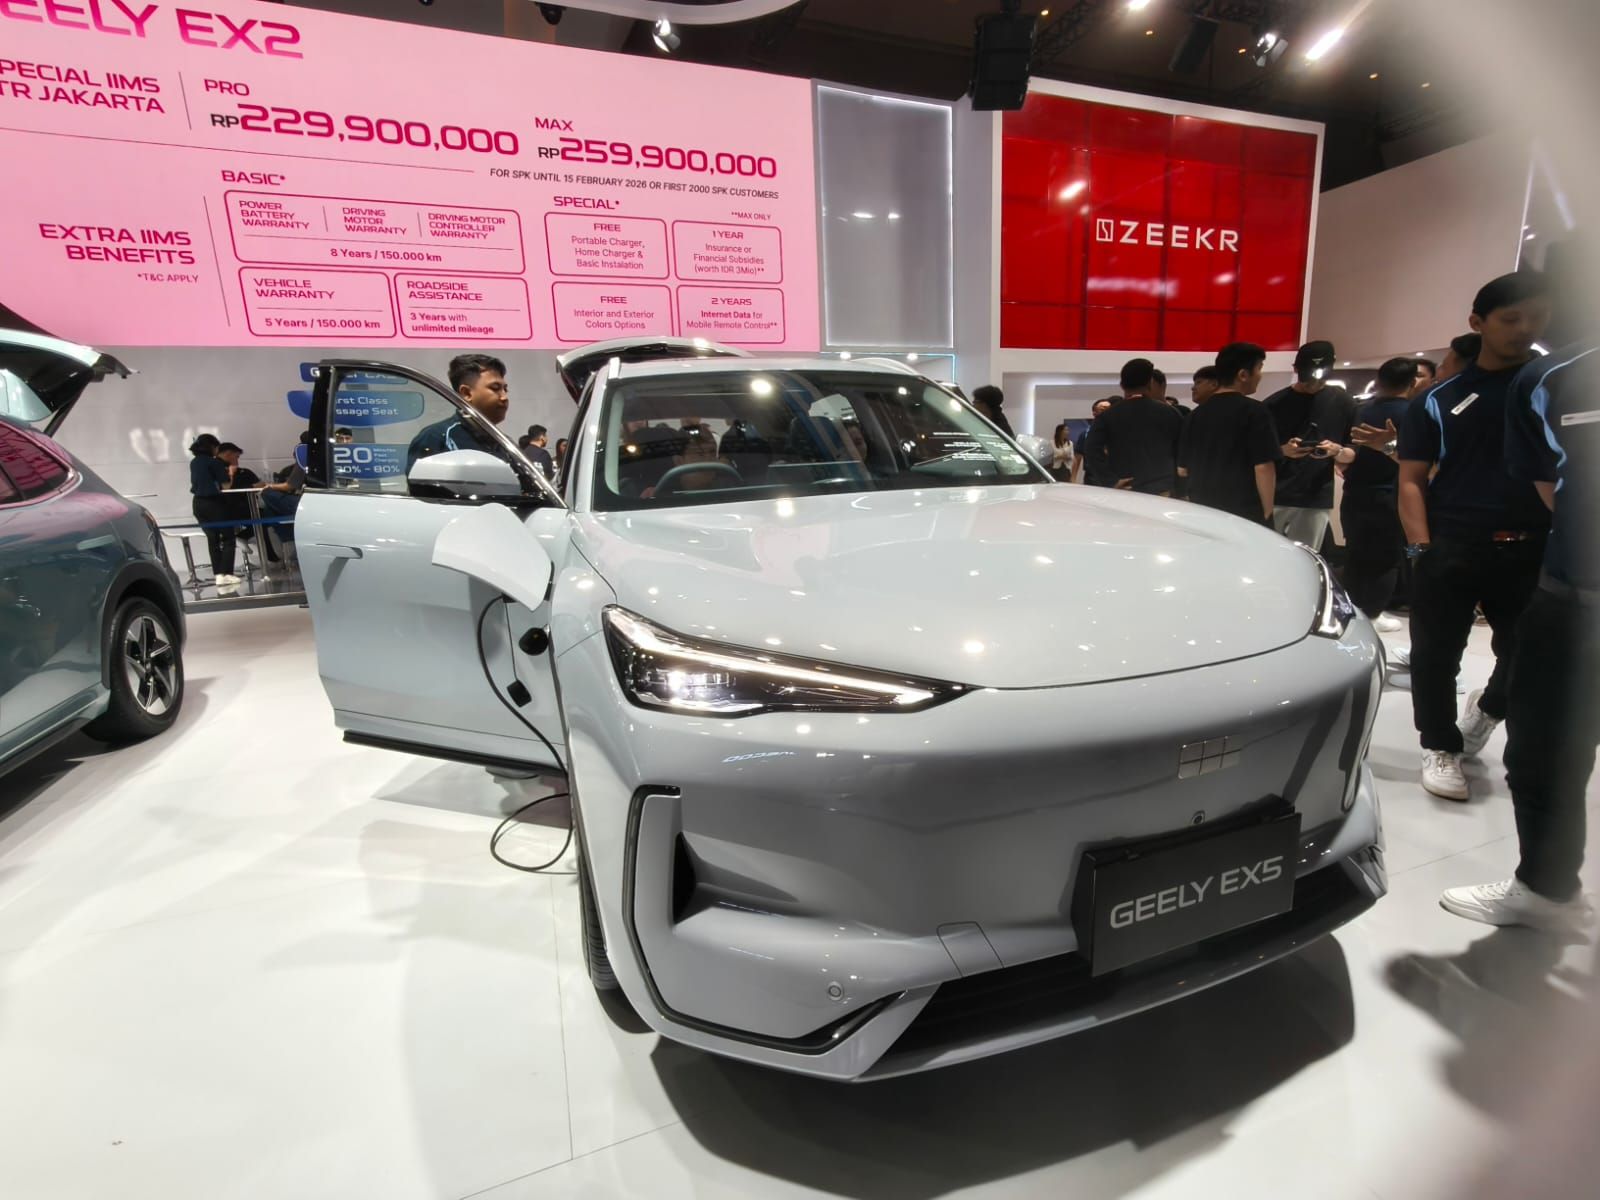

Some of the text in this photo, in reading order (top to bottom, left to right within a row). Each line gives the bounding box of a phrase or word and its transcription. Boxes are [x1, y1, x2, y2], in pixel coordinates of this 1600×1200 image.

[176, 8, 304, 60] EX2
[0, 58, 161, 93] PECIAL IIMS
[203, 78, 250, 97] PRO
[39, 85, 165, 114] JAKARTA
[535, 116, 574, 132] MAX
[489, 167, 779, 199] FOR SPK UNTIL 15 FEBRUARY 2026 OR FIRST 2000 SPK CUSTOMERS
[239, 200, 283, 210] POWER
[240, 209, 296, 220] BATTERY
[342, 207, 386, 217] DRIVING
[754, 213, 771, 221] ONLY
[242, 218, 310, 230] WARRANTY
[343, 216, 384, 225] MOTOR
[428, 212, 506, 225] DRIVING MOTOR
[345, 224, 407, 235] WARRANTY
[429, 221, 496, 232] CONTROLLER
[593, 223, 621, 232] FREE
[38, 223, 191, 246] EXTRA IIMS
[430, 230, 489, 240] WARRANTY
[717, 230, 744, 240] YEAR
[1119, 219, 1239, 252] ZEEKR
[571, 235, 646, 249] Portable Charger,
[574, 248, 644, 260] Home Charger &
[705, 243, 752, 254] Insurance or
[65, 244, 195, 265] BENEFITS
[330, 248, 338, 257] 8
[339, 248, 372, 259] Years
[380, 250, 425, 261] 150.000
[426, 252, 442, 262] km
[693, 253, 764, 265] Financial Subsidies
[576, 258, 600, 268] Basic
[694, 264, 720, 274] (worth
[721, 265, 735, 274] IDR
[167, 274, 199, 283] APPLY
[253, 277, 312, 289] VEHICLE
[406, 280, 469, 291] ROADSIDE
[255, 289, 336, 300] WARRANTY
[408, 290, 483, 301] ASSISTANCE
[600, 295, 628, 304] FREE
[711, 297, 719, 305] 2
[409, 312, 467, 322] 3 Years with
[573, 309, 655, 319] Interior and Exterior
[701, 310, 763, 319] Internet Data for
[264, 317, 273, 327] 5
[274, 318, 308, 328] Years
[316, 318, 362, 329] 150.000
[364, 319, 381, 329] km
[585, 320, 646, 330] Colors Options
[686, 320, 712, 329] Mobile
[713, 321, 742, 329] Remote
[411, 323, 494, 335] unlimited mileage
[335, 396, 388, 405] rst Class
[335, 407, 399, 417] ssage Seat
[333, 446, 373, 464] 20
[1110, 855, 1284, 929] GEELY EX5
